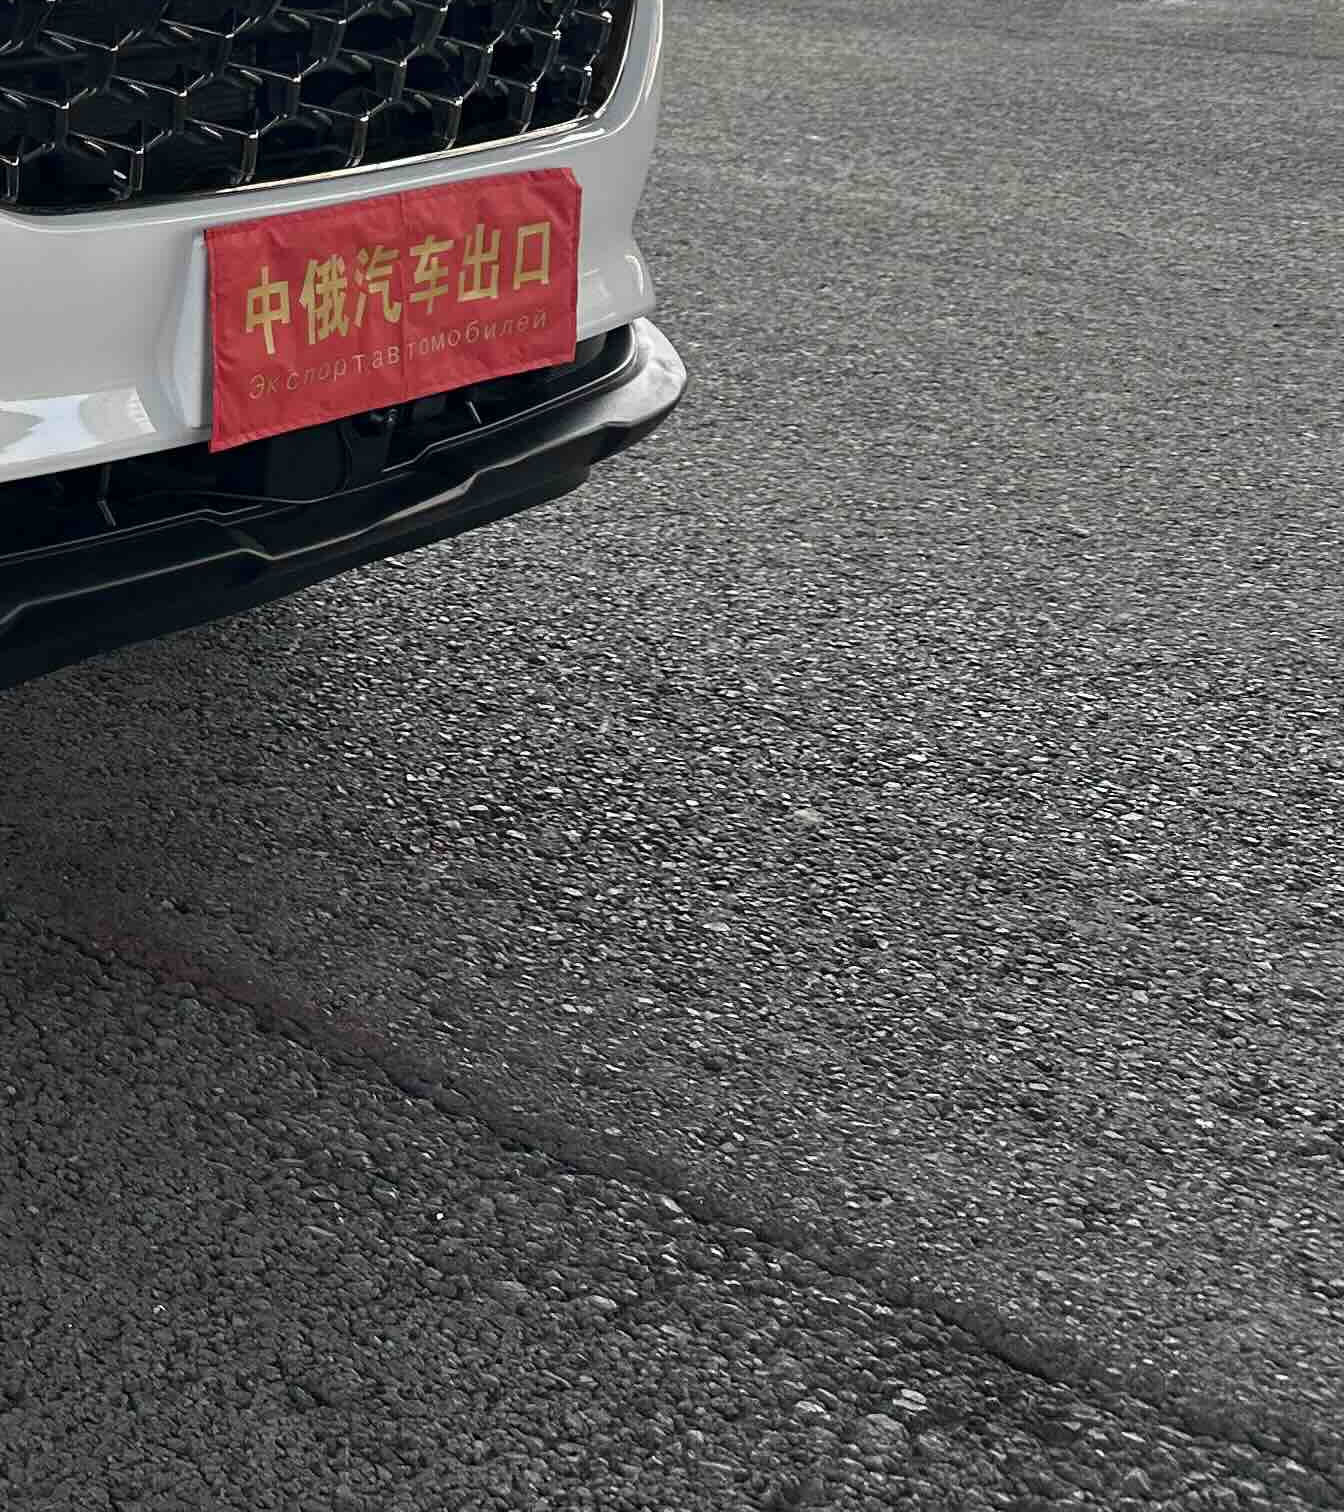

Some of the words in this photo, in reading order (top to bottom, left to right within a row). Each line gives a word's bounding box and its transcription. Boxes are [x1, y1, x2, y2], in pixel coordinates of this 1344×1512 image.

[245, 221, 552, 355] 中俄汽车出口
